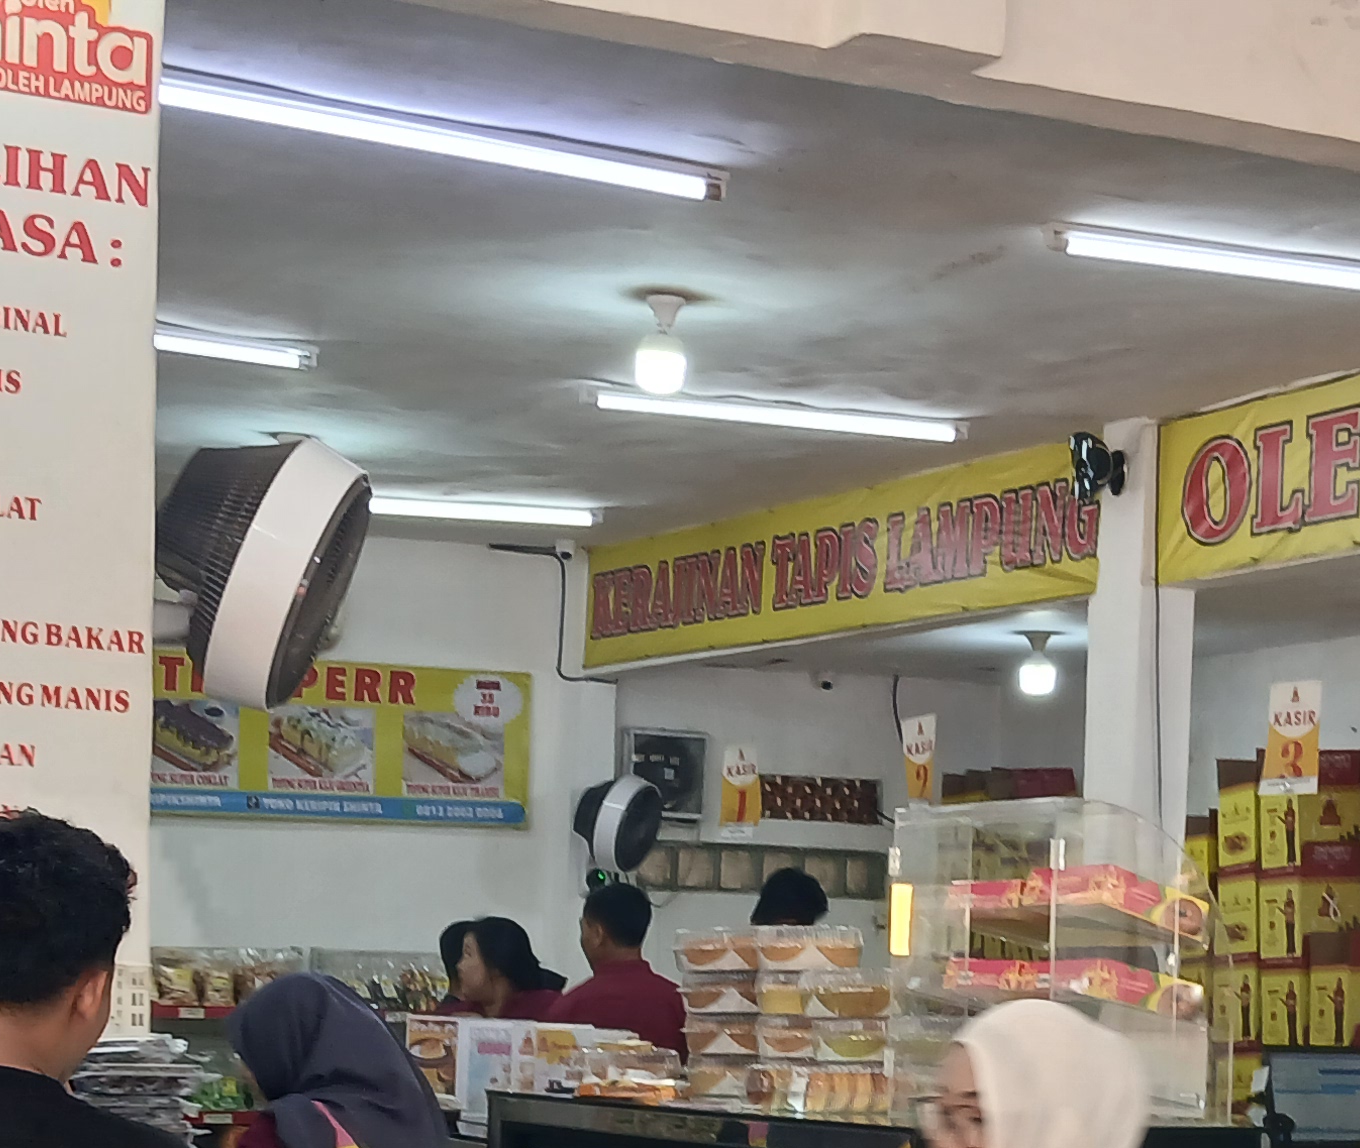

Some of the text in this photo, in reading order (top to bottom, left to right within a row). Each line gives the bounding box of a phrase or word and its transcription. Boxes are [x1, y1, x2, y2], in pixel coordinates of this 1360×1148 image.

[48, 76, 147, 113] LAMPUNG
[771, 516, 880, 612] TAPIS
[884, 478, 1101, 594] LAMPUNG
[43, 618, 146, 655] BAKAR
[38, 680, 131, 714] MANIS
[1273, 709, 1317, 727] KASIR
